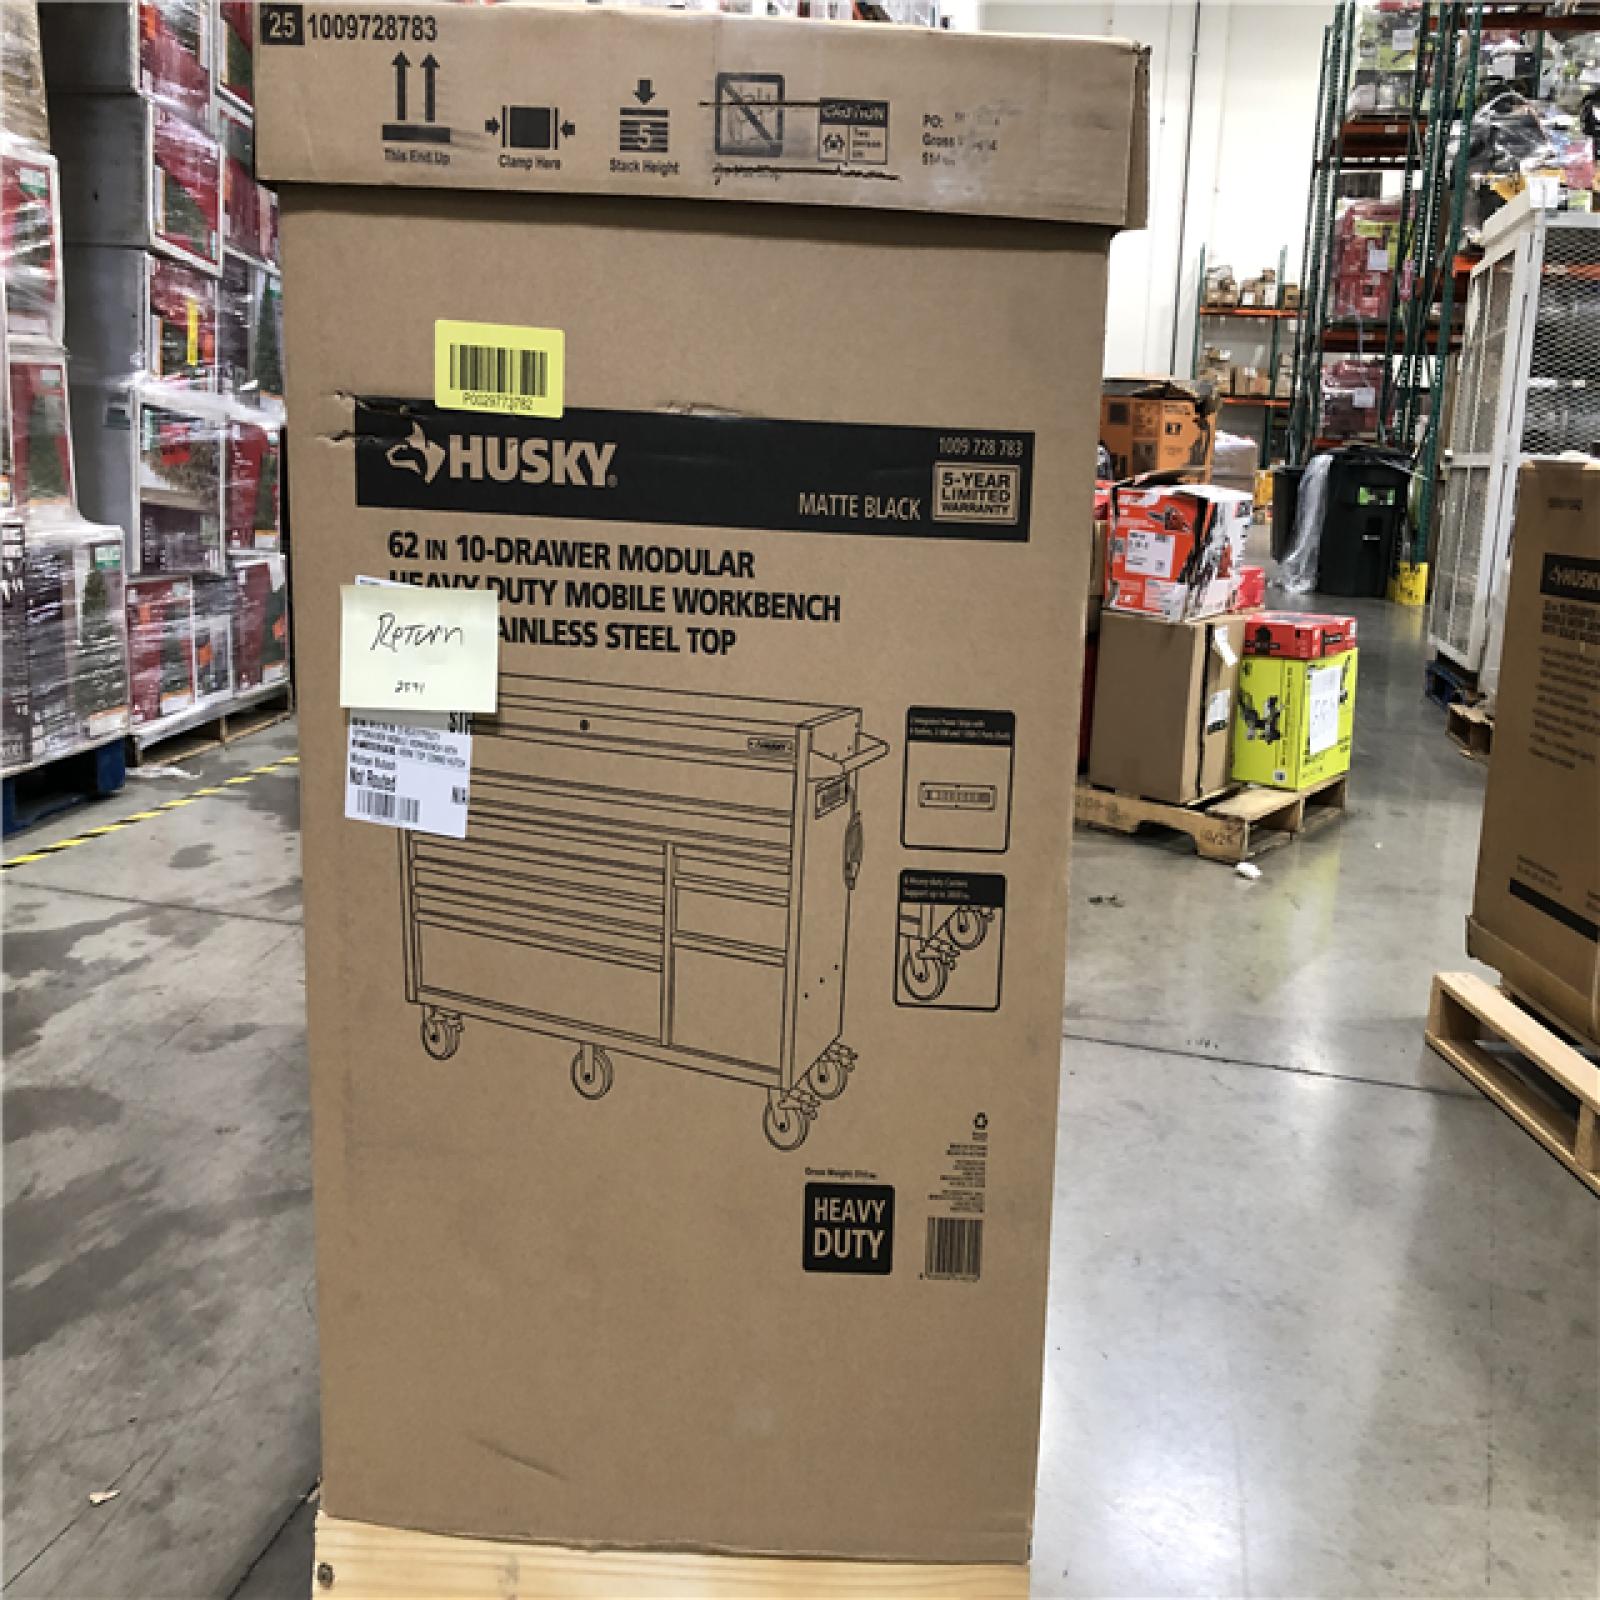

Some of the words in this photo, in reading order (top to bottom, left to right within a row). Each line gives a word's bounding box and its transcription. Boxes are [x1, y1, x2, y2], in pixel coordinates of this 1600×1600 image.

[269, 12, 296, 38] 25
[308, 14, 438, 42] 1009728783
[384, 147, 406, 162] This
[409, 149, 432, 164] End
[434, 151, 451, 165] Up
[499, 154, 533, 171] Clamp
[642, 159, 680, 177] Height
[449, 434, 617, 487] HUSKY
[973, 439, 996, 456] 728
[942, 472, 1011, 488] 5-YEAR
[799, 492, 858, 518] MATTE
[864, 495, 921, 521] BLACK
[942, 487, 1011, 503] LIMITED
[388, 530, 419, 558] 62
[425, 539, 447, 560] IN
[456, 534, 610, 570] 10-DRAWER
[618, 544, 755, 578] MODULAR
[565, 580, 666, 613] MOBILE
[672, 586, 841, 622] WORKBENCH
[605, 622, 681, 654] STEEL
[686, 627, 736, 655] TOP
[814, 1196, 886, 1224] HEAVY
[813, 1226, 885, 1261] DUTY
